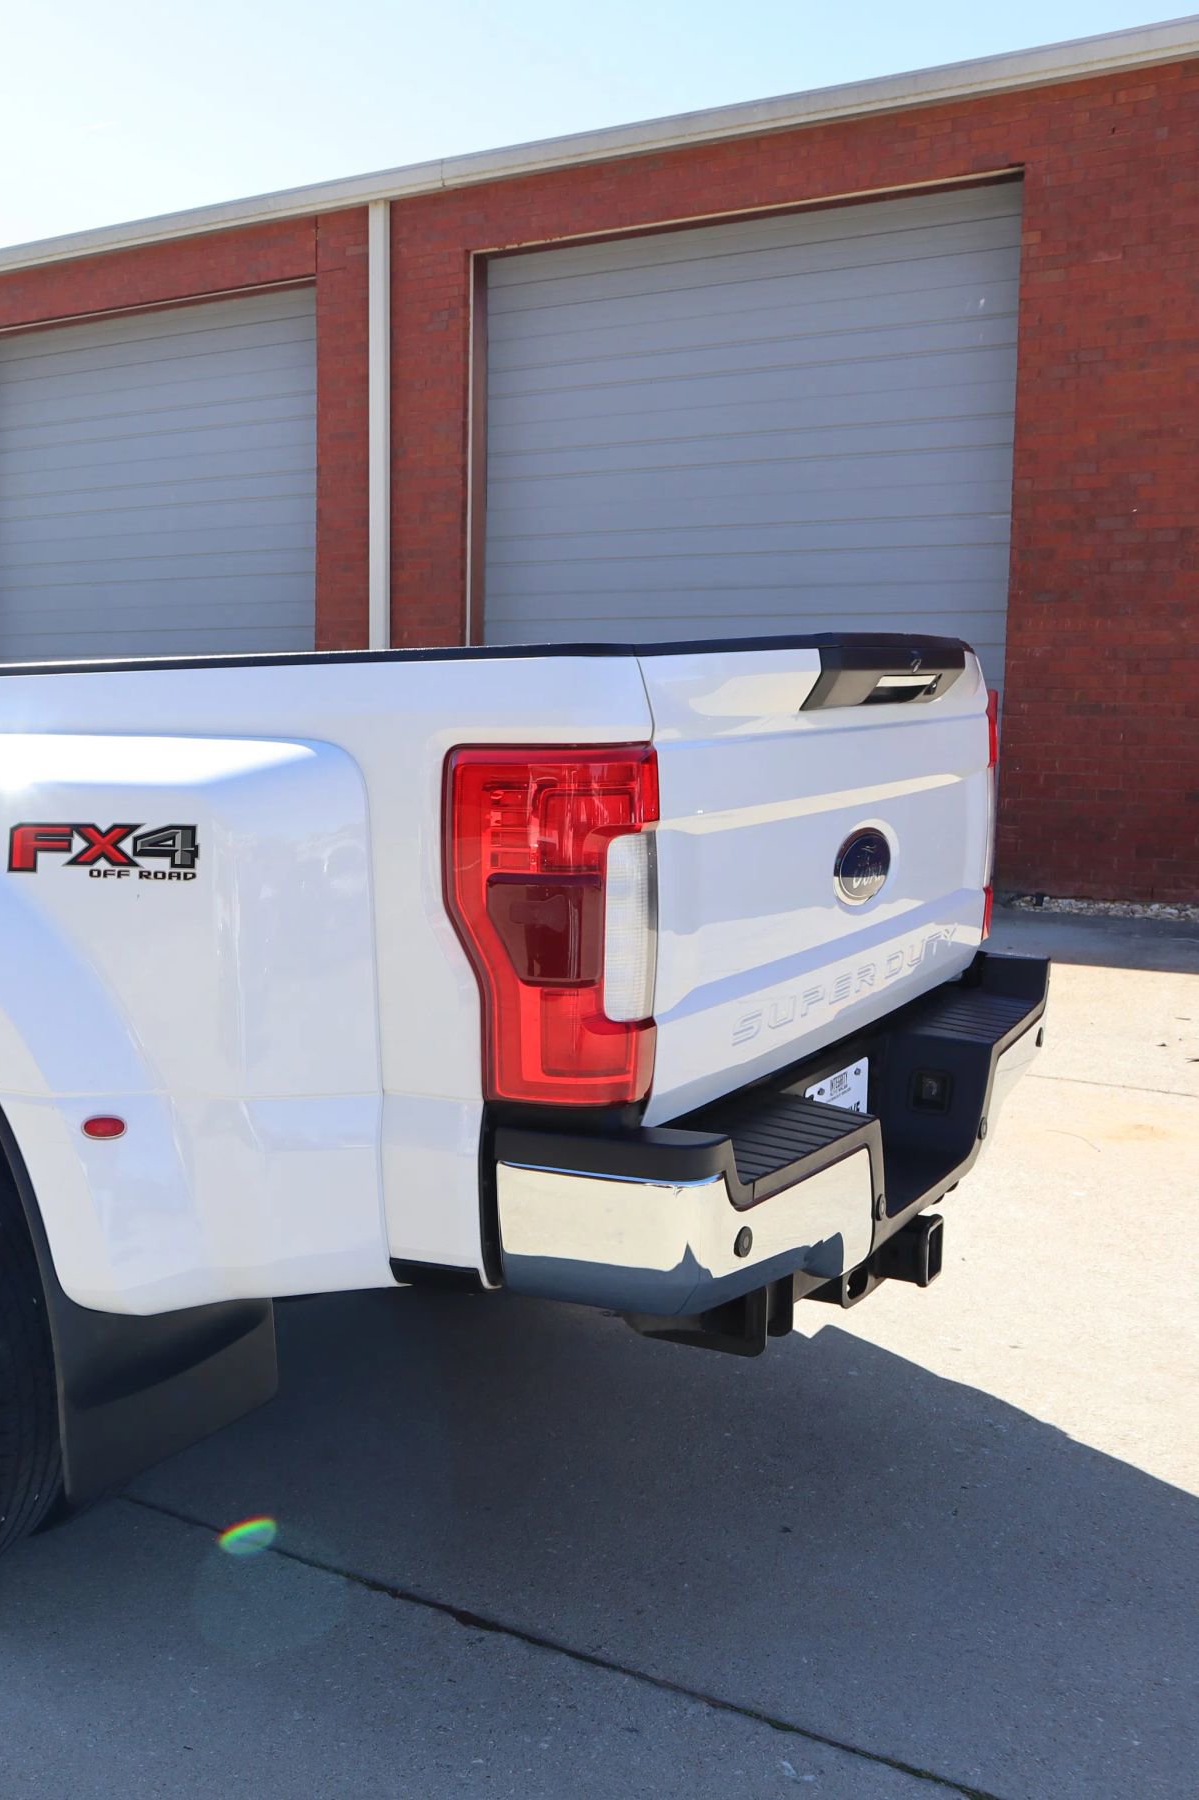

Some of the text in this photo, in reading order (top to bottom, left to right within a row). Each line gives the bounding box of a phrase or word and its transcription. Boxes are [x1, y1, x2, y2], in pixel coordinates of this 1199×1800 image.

[7, 823, 200, 873] FX4
[88, 868, 197, 881] OFF ROAD
[732, 922, 959, 1047] SUPER DUTY
